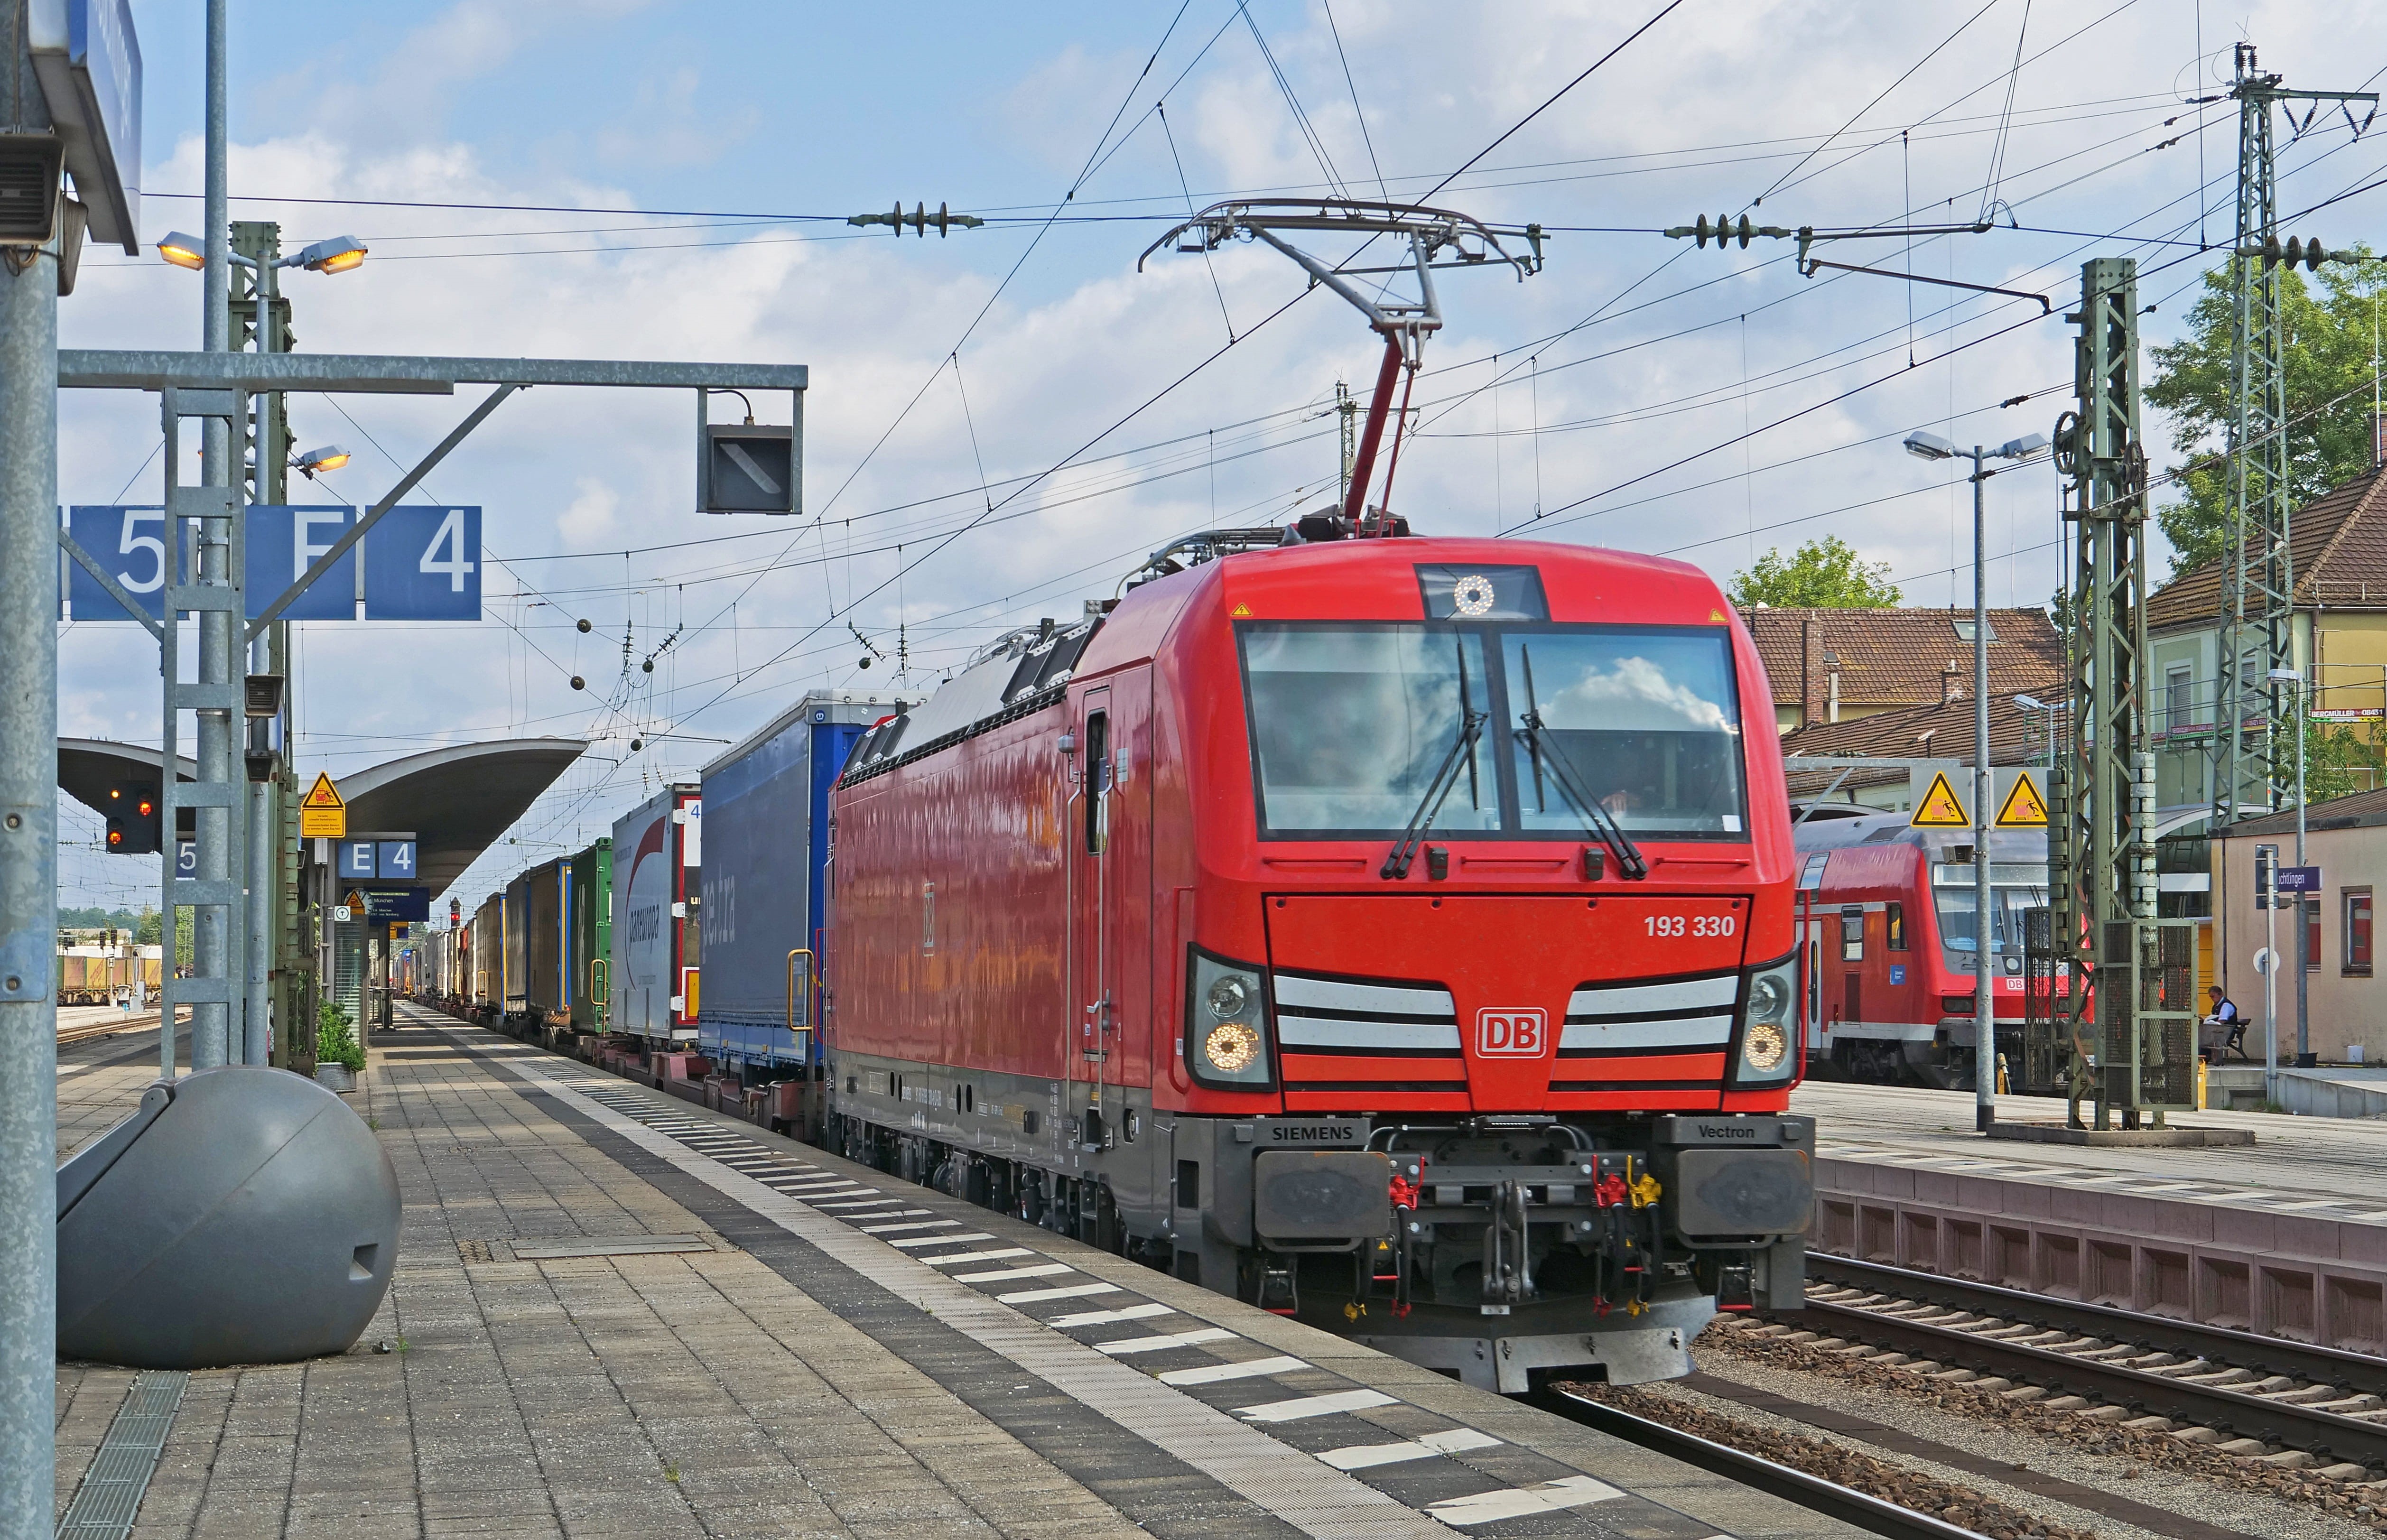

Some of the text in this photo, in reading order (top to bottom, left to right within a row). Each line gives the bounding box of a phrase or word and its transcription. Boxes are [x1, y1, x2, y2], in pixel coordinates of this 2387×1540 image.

[117, 510, 166, 594] 5
[419, 510, 474, 592] 4
[691, 805, 700, 818] 4
[179, 843, 196, 870] 5
[353, 844, 411, 870] E 4
[629, 904, 659, 956] paneuropa
[1644, 916, 1735, 937] 193 330
[2008, 980, 2023, 988] DB
[1487, 1017, 1536, 1048] DB
[1272, 1126, 1353, 1141] SIEMENS
[1698, 1125, 1755, 1138] Vectron
